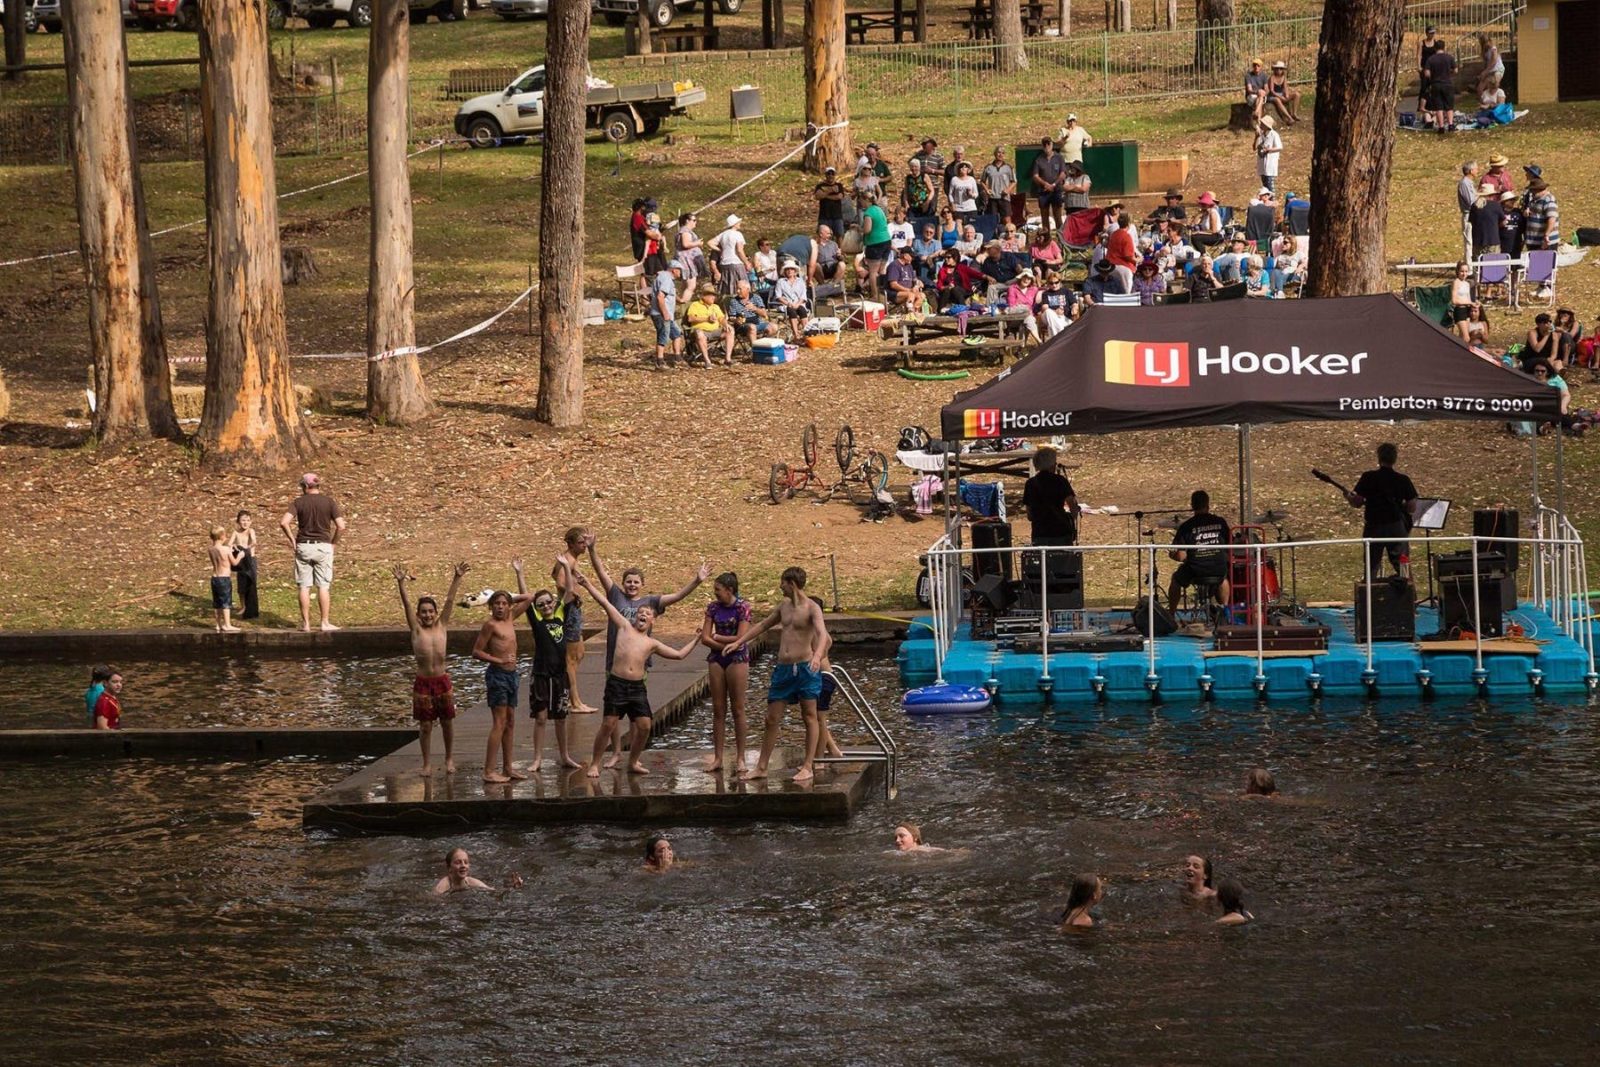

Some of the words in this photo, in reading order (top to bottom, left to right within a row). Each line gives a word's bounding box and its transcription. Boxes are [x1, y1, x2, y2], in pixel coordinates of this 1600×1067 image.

[1144, 347, 1180, 384] LJ
[1197, 345, 1368, 376] Hooker
[1339, 395, 1437, 411] Pemberton
[1443, 396, 1486, 412] 9776
[1490, 398, 1534, 412] 0000
[980, 411, 996, 435] LJ
[1002, 410, 1073, 429] Hooker
